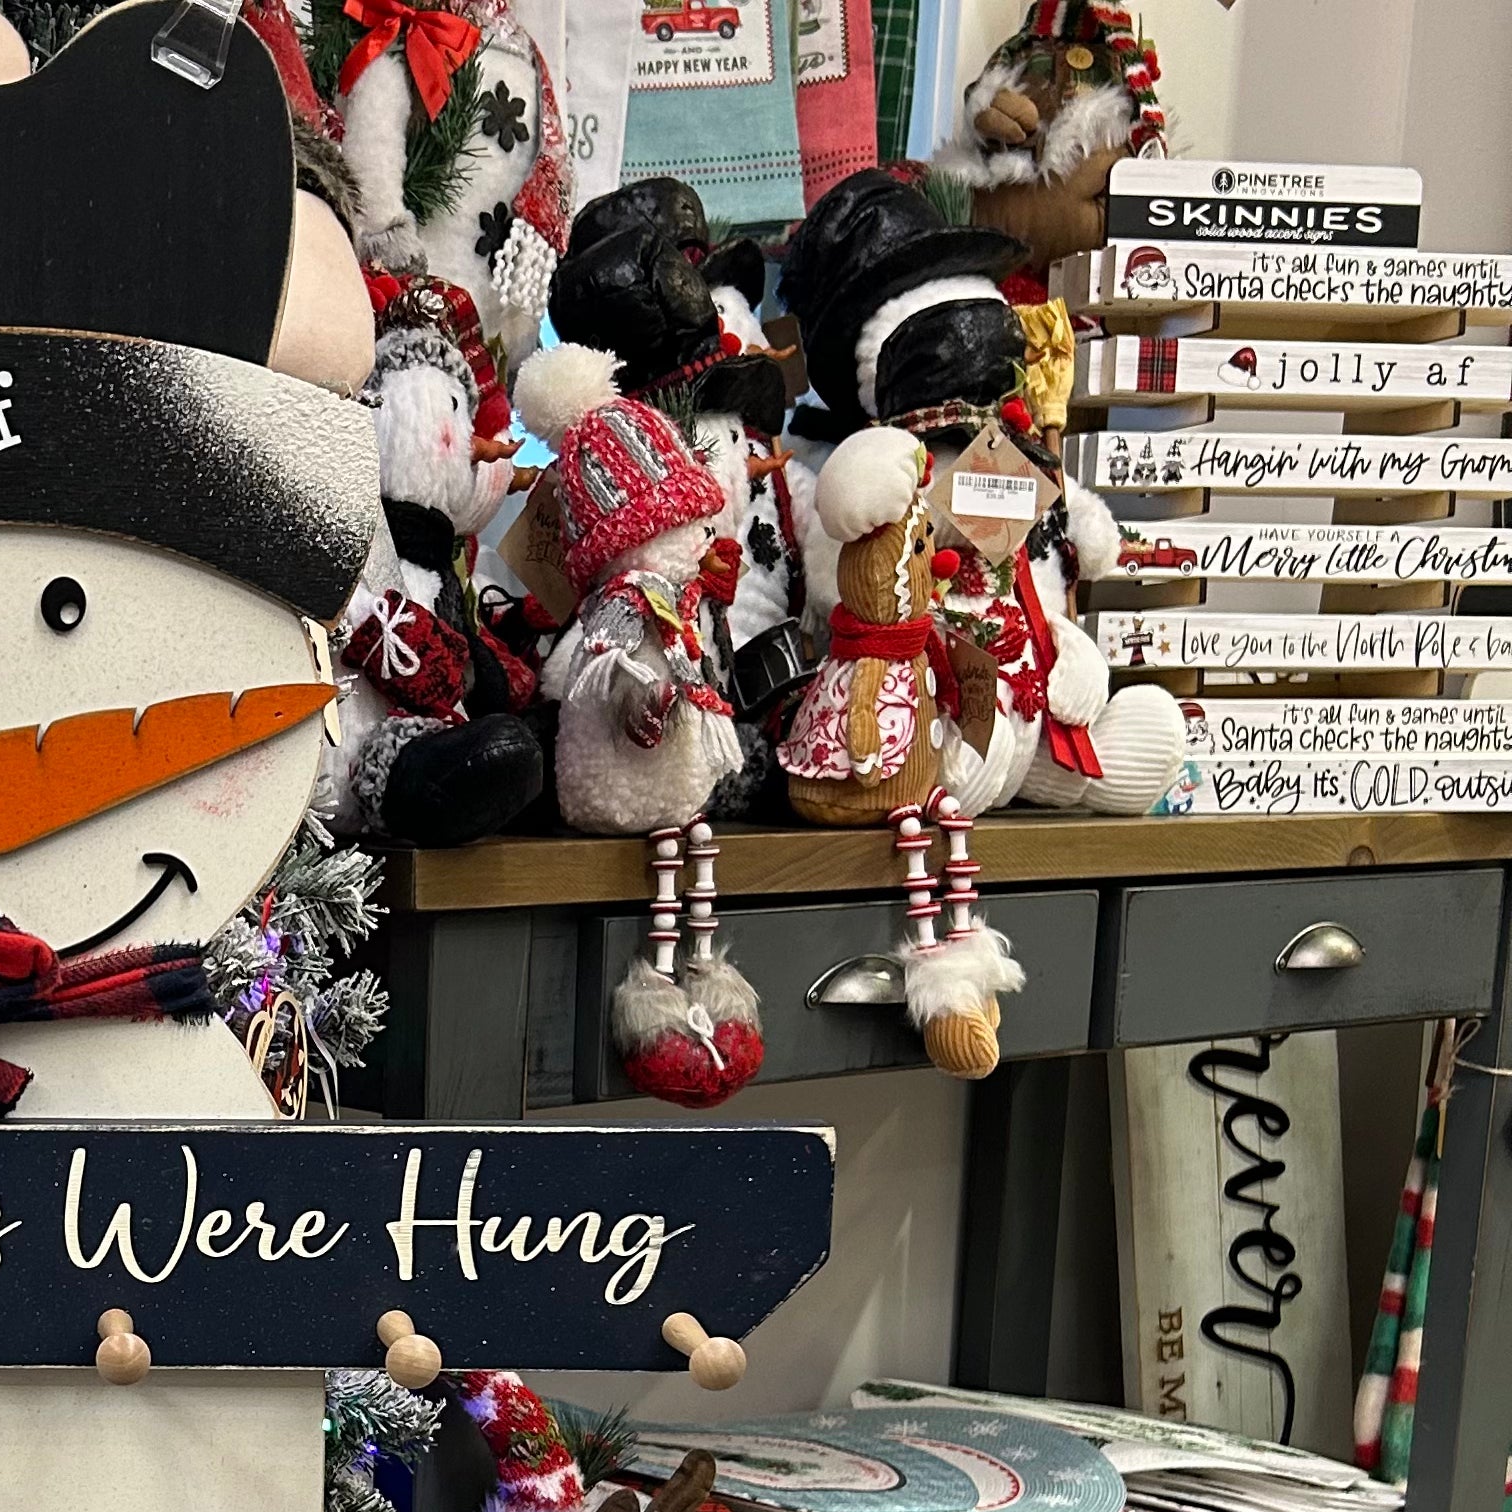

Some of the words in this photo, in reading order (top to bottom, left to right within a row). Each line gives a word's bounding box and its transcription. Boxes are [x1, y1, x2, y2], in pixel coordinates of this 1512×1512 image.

[637, 60, 679, 75] HAPPY
[683, 58, 711, 73] NEW
[715, 56, 748, 71] YEAR
[1236, 187, 1324, 197] INNOVATIONS
[1237, 173, 1325, 188] PINETREE
[1147, 199, 1384, 234] SKINNIES
[1184, 263, 1264, 300] Santa
[1271, 275, 1354, 302] checks
[1360, 276, 1403, 303] the
[1410, 279, 1512, 307] naughty
[1251, 251, 1284, 273] it's
[1291, 252, 1317, 274] all
[1324, 254, 1360, 276] fun
[1384, 258, 1448, 279] games
[1453, 259, 1501, 279] until
[1272, 352, 1398, 392] jolly
[1426, 356, 1475, 387] af
[1308, 442, 1372, 477] with
[1379, 452, 1431, 485] my
[1441, 443, 1512, 481] Gnom
[1258, 528, 1300, 542] HAVE
[1308, 529, 1385, 543] YOURSELF
[1390, 531, 1400, 543] A
[1200, 535, 1324, 580] Merry
[1325, 542, 1388, 576] Little
[1393, 535, 1512, 579] Christm
[1180, 618, 1220, 664] Love
[1224, 625, 1272, 667] you
[1281, 634, 1295, 658] to
[1298, 631, 1328, 657] the
[1336, 620, 1405, 662] North
[1415, 619, 1463, 668] Pole
[1487, 626, 1512, 660] ba
[1221, 718, 1293, 753] Santa
[1299, 725, 1374, 752] checks
[1380, 724, 1418, 752] the
[1282, 703, 1313, 725] it's
[1318, 703, 1342, 724] all
[1348, 704, 1380, 725] fun
[1400, 706, 1457, 727] games
[1463, 705, 1507, 725] until
[1212, 760, 1303, 815] Baby
[1350, 759, 1428, 811] COLD
[1434, 768, 1512, 808] outsi
[64, 1144, 349, 1284] Were
[386, 1148, 696, 1306] Hung
[1188, 1036, 1303, 1446] rever
[1157, 1305, 1184, 1364] BE
[1159, 1371, 1187, 1422] M
